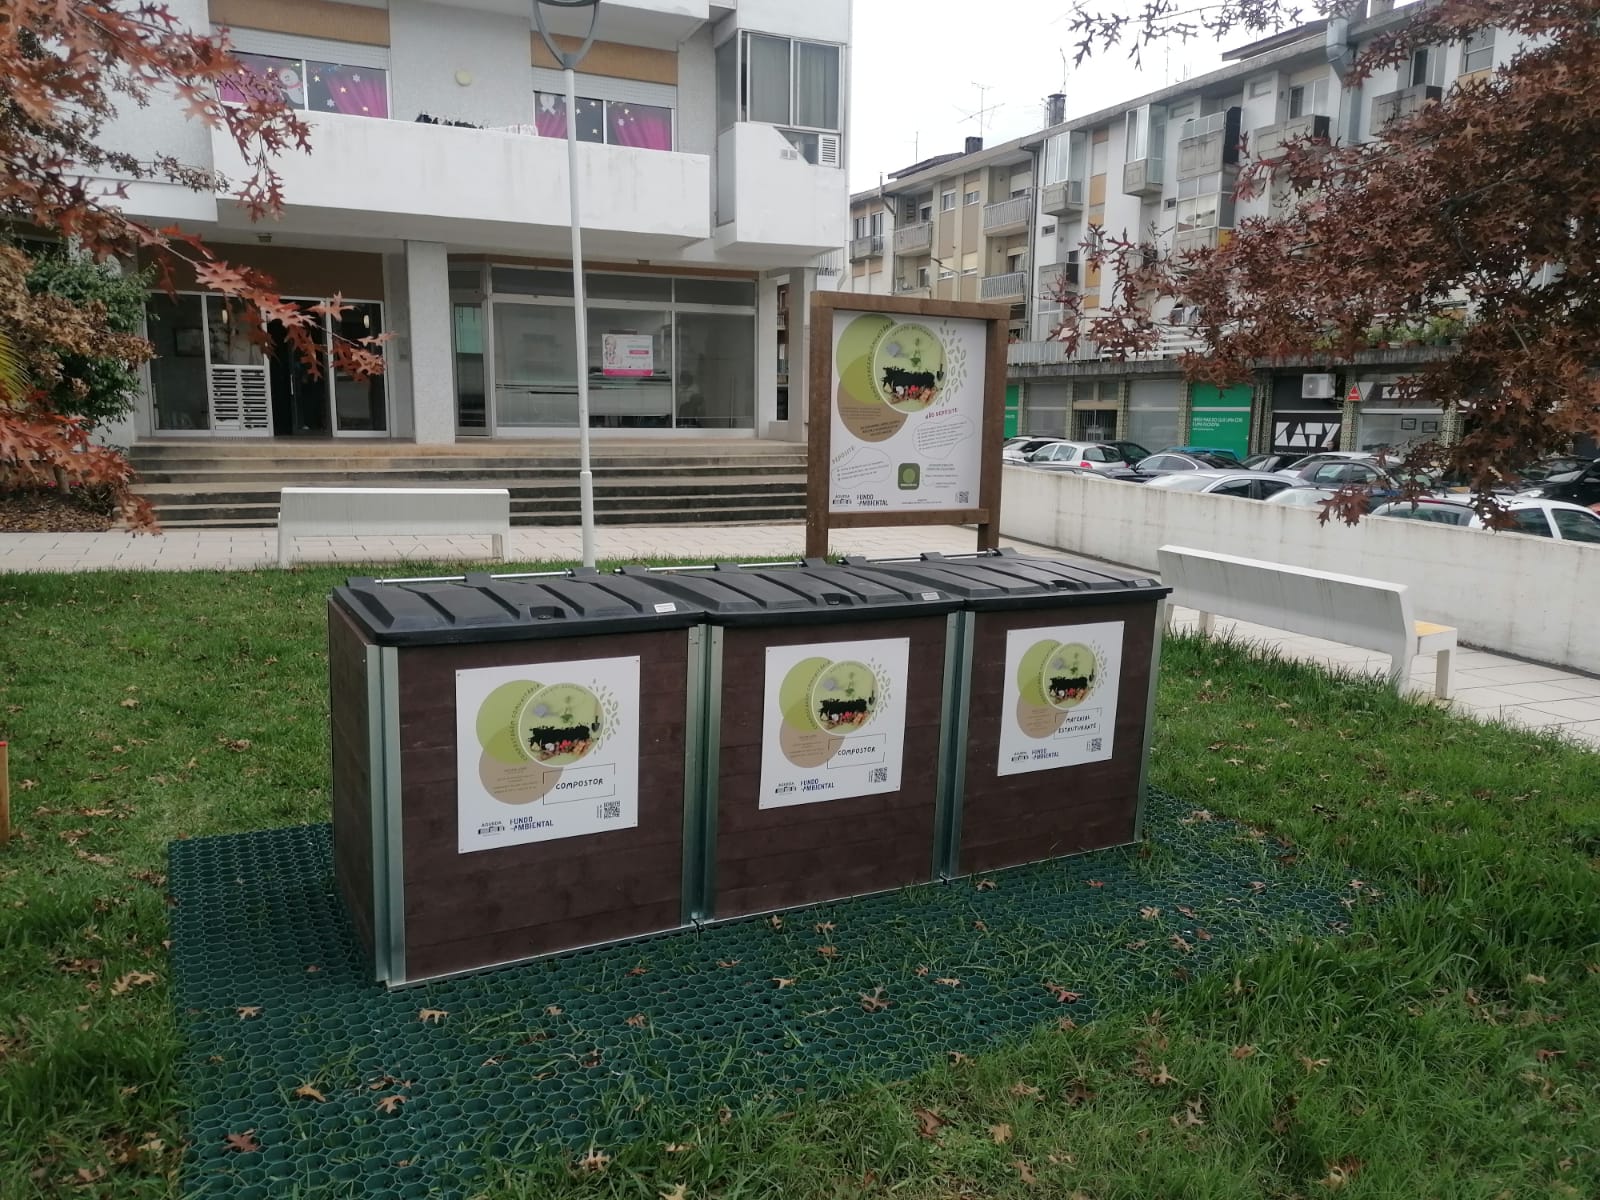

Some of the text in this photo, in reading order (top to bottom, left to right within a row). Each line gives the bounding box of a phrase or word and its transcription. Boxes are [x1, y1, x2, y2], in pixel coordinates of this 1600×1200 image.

[1274, 422, 1341, 448] KATY
[1065, 714, 1090, 724] MATERIAL
[837, 746, 876, 756] COMPOSTOR
[555, 778, 604, 790] COMPOSTOR
[801, 778, 819, 786] FUNDO
[510, 816, 533, 826] FUNDO
[511, 820, 554, 832] AMBIENTAL
